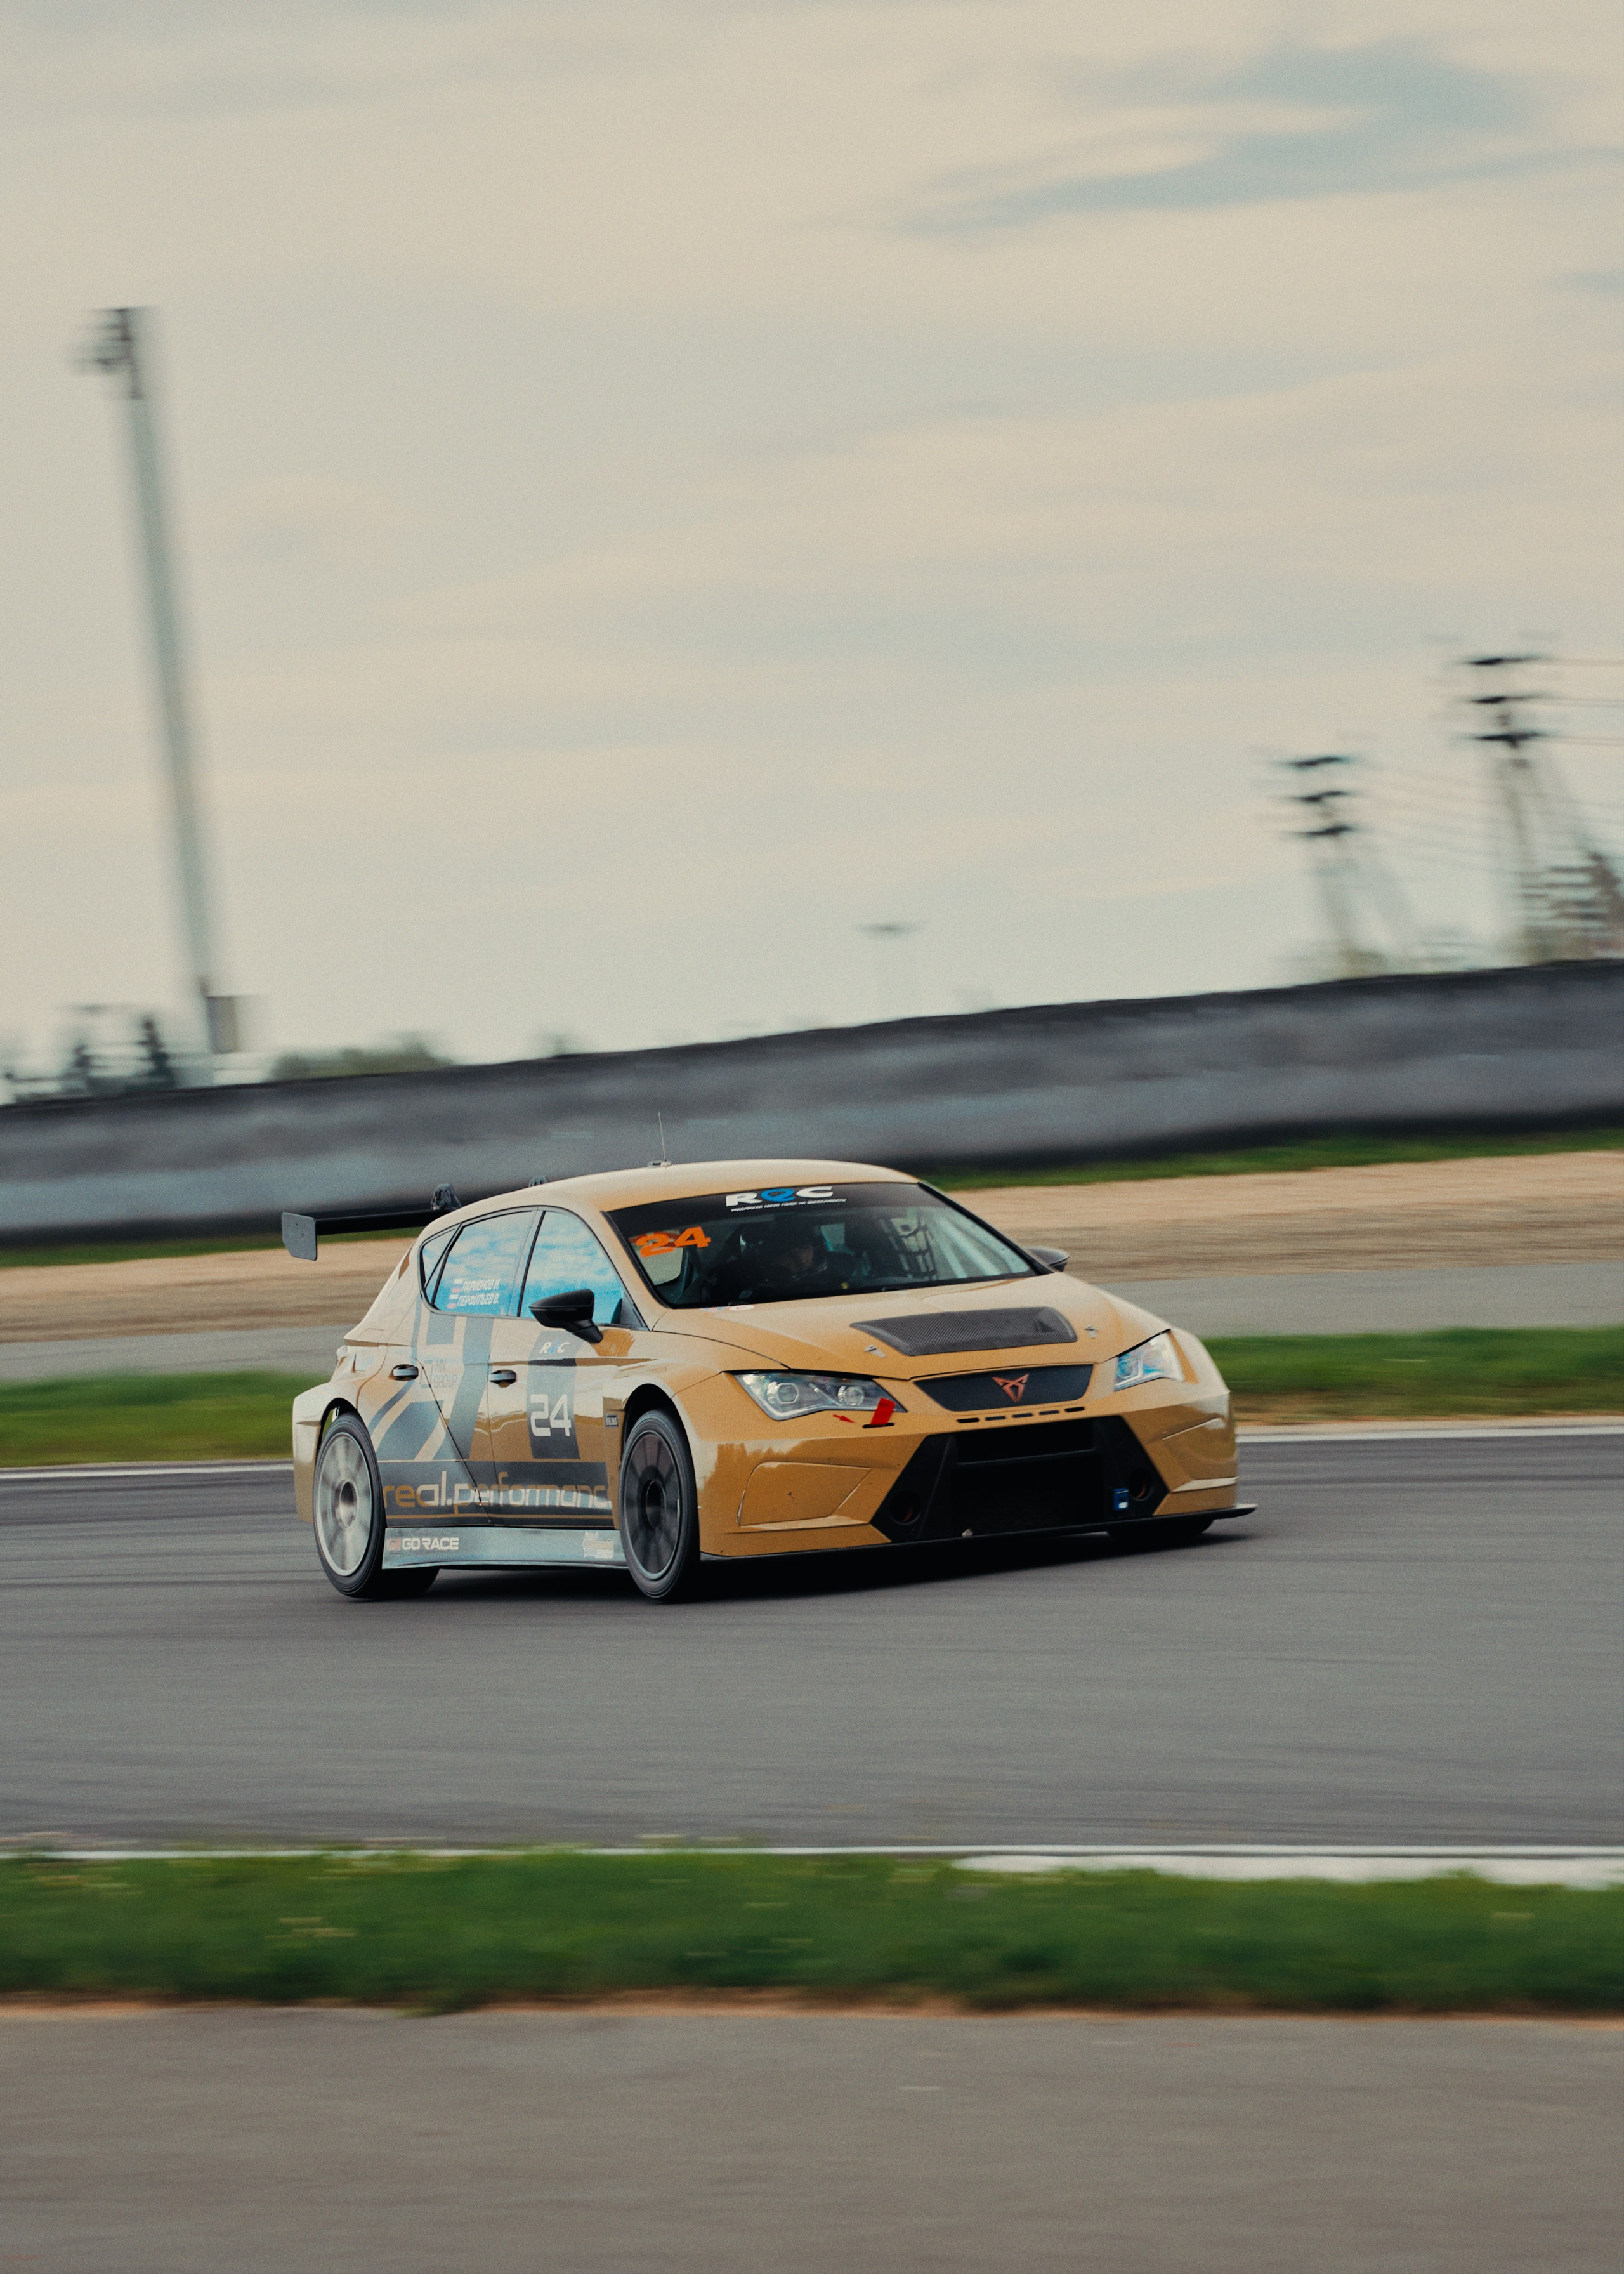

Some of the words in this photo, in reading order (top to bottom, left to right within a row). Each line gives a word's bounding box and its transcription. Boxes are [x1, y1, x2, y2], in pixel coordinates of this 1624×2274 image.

[636, 1226, 712, 1258] 24
[461, 1279, 494, 1292] ЛАРИОНОВ
[457, 1293, 494, 1307] ПЕРФИЛЬЕВ
[433, 1374, 457, 1388] GROUP
[530, 1394, 572, 1436] 24
[383, 1470, 613, 1515] real.performanc
